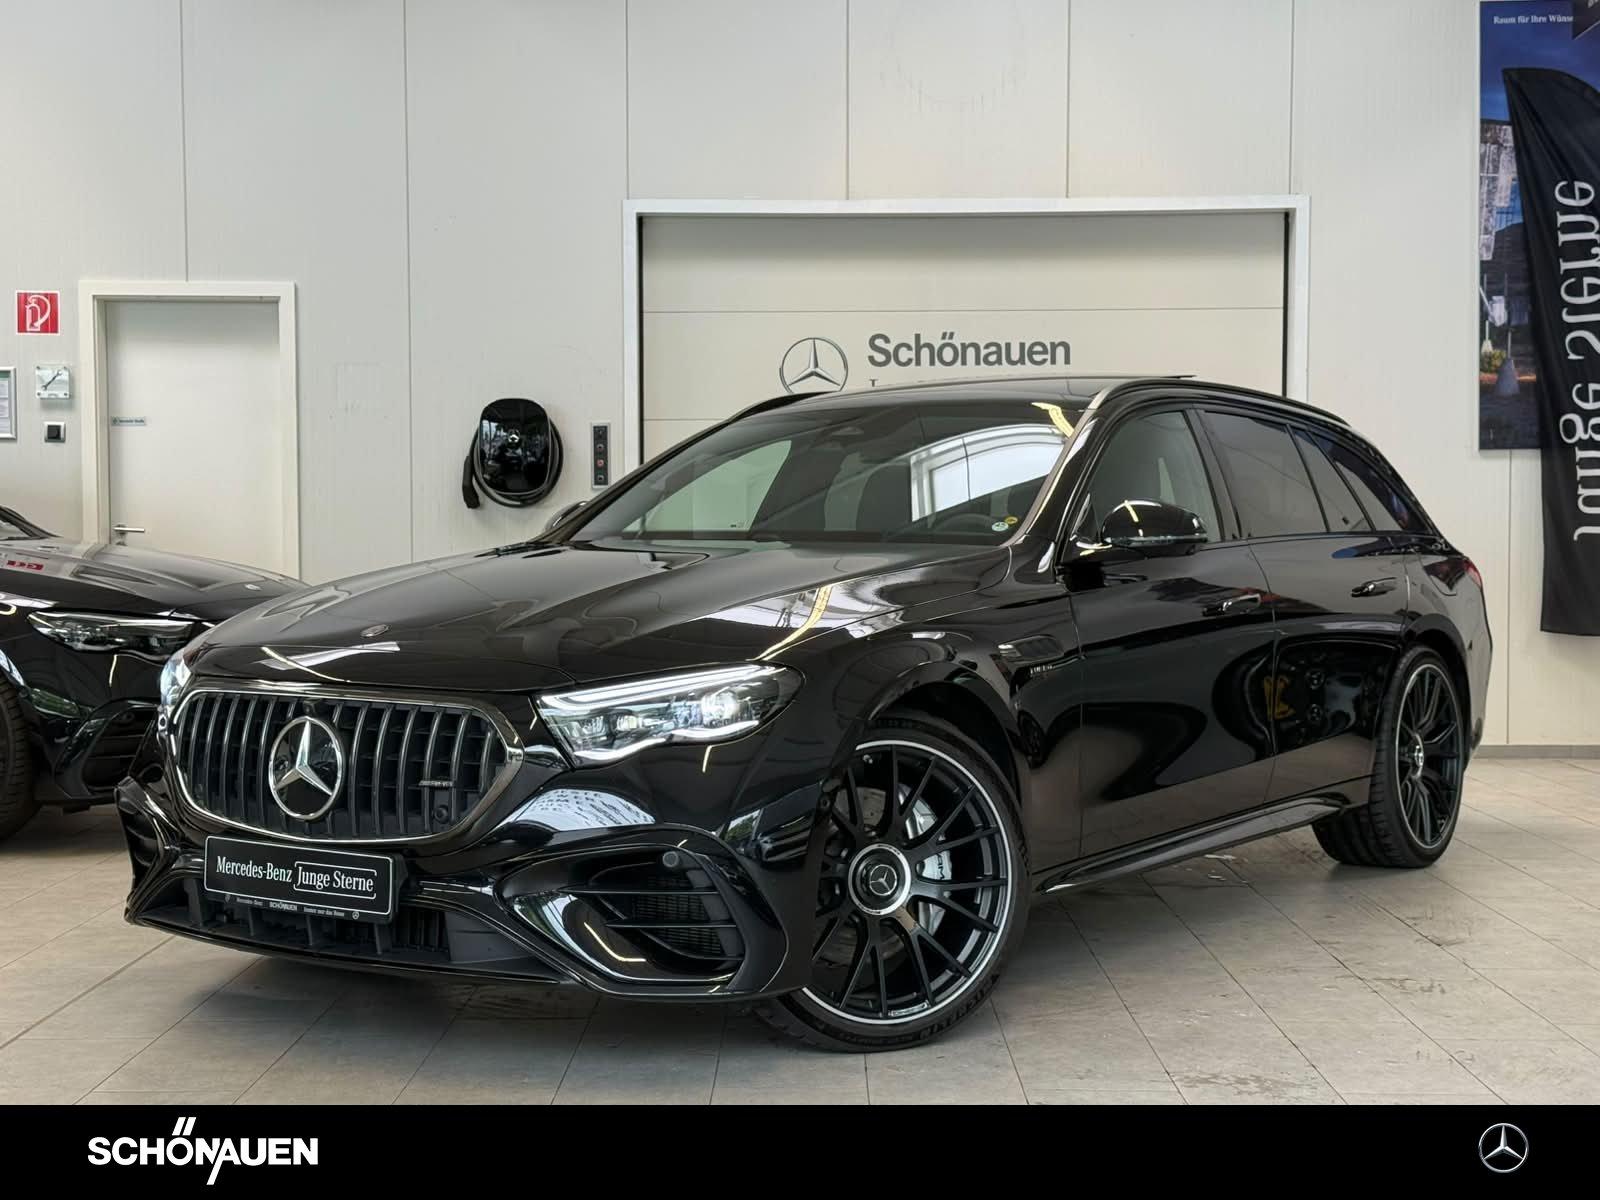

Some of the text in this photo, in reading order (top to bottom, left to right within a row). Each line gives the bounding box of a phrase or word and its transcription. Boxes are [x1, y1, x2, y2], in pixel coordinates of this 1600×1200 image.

[1493, 15, 1516, 24] Raum
[1517, 15, 1530, 24] für
[1531, 15, 1547, 23] Ihre
[867, 331, 1071, 368] Schönauen
[215, 855, 374, 892] Mercedes-Benz Junge Sterne
